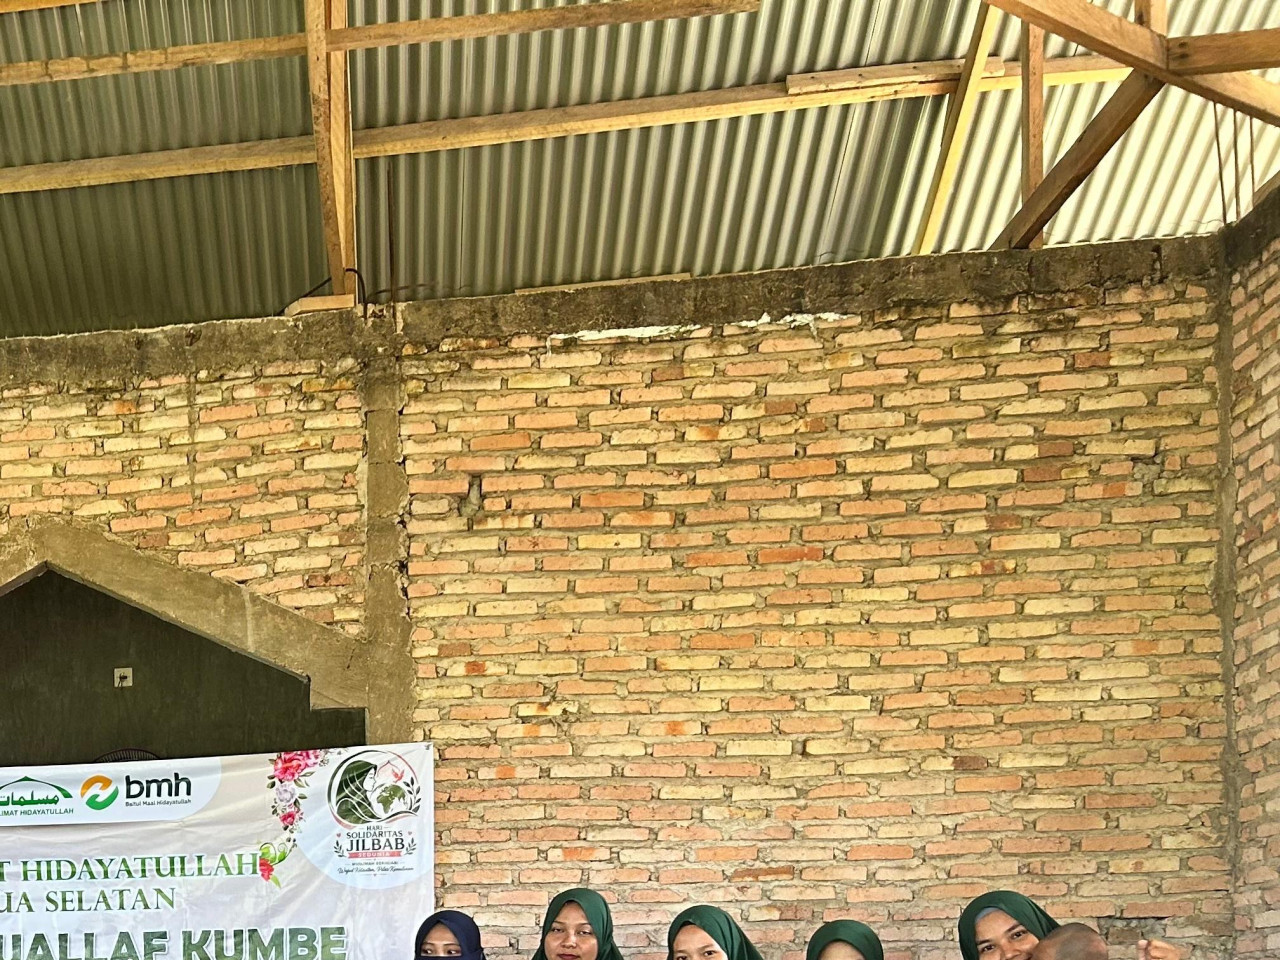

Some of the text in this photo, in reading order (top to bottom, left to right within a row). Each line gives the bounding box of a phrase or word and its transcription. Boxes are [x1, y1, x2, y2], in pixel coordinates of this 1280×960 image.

[125, 772, 191, 799] bmh
[20, 808, 74, 816] HIDAYATULLAH
[346, 830, 403, 839] SOLIDARITAS
[346, 838, 405, 852] JILBAB
[21, 852, 258, 882] HIDAYATULLAH
[45, 887, 175, 912] SELATAN
